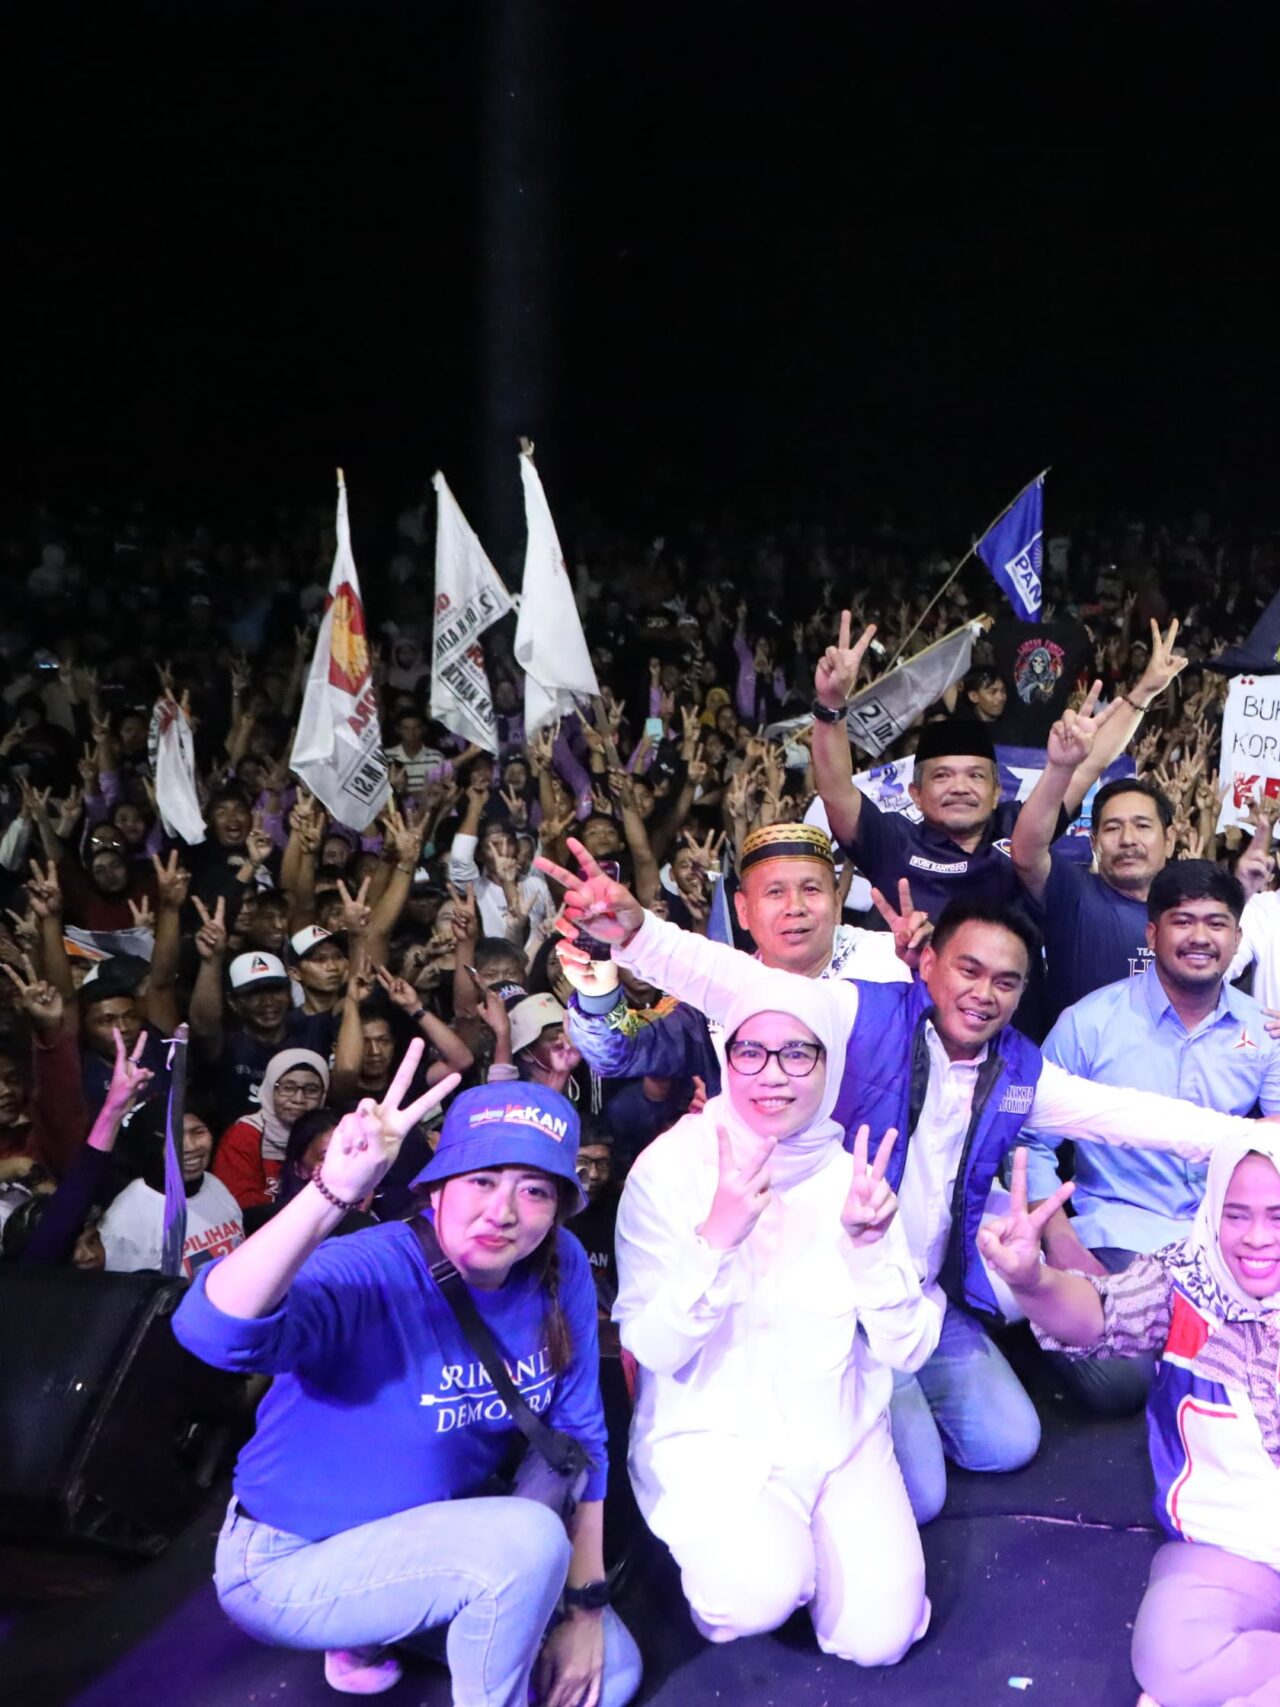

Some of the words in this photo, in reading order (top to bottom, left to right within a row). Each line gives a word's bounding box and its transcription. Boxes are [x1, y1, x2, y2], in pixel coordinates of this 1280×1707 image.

[1015, 556, 1042, 604] PAN
[858, 704, 881, 724] 2
[1137, 947, 1156, 957] TEA
[183, 1220, 242, 1252] PILIHAN
[436, 1388, 553, 1433] DEMORA
